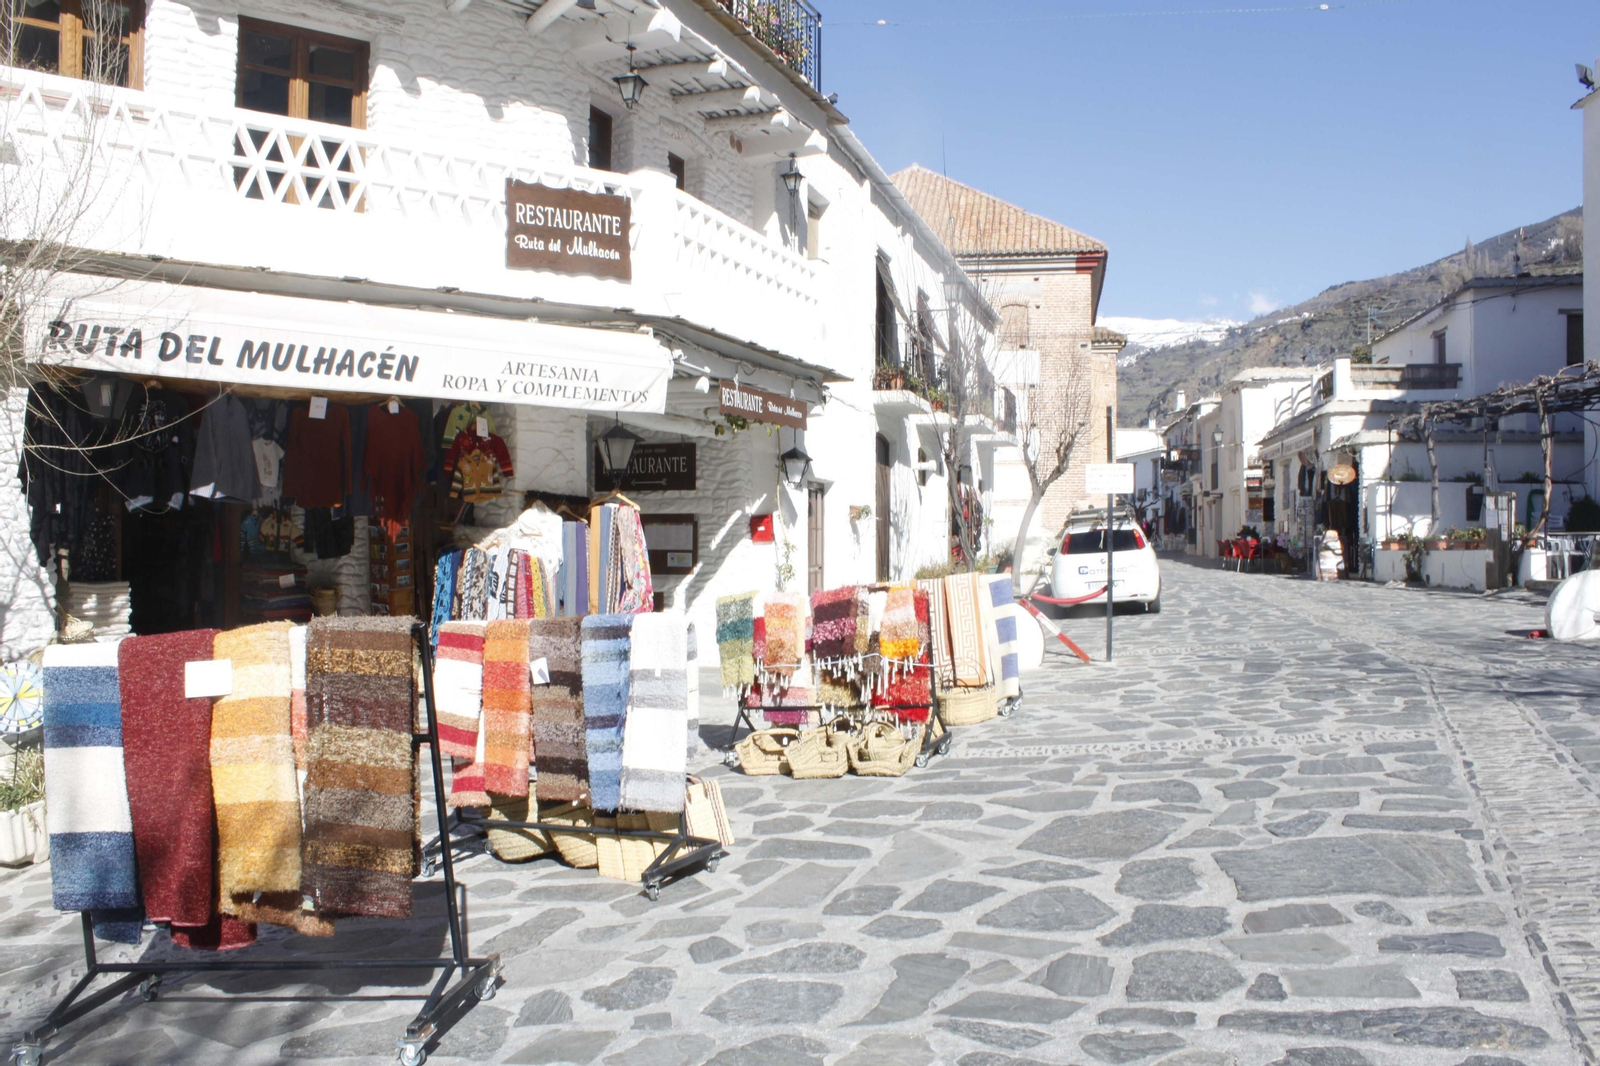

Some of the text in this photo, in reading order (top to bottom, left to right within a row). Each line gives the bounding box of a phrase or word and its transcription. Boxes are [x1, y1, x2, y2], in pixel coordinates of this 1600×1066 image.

[515, 202, 621, 236] RESTAURANTE
[514, 234, 620, 260] Ruta del Mulhacén
[44, 320, 420, 382] RUTA DEL MULHACÉN
[501, 361, 600, 383] ARTESANIA
[441, 374, 649, 403] ROPA Y COMPLEMENTOS
[722, 387, 763, 413] RESTAURANTE
[603, 456, 687, 474] AURANTE
